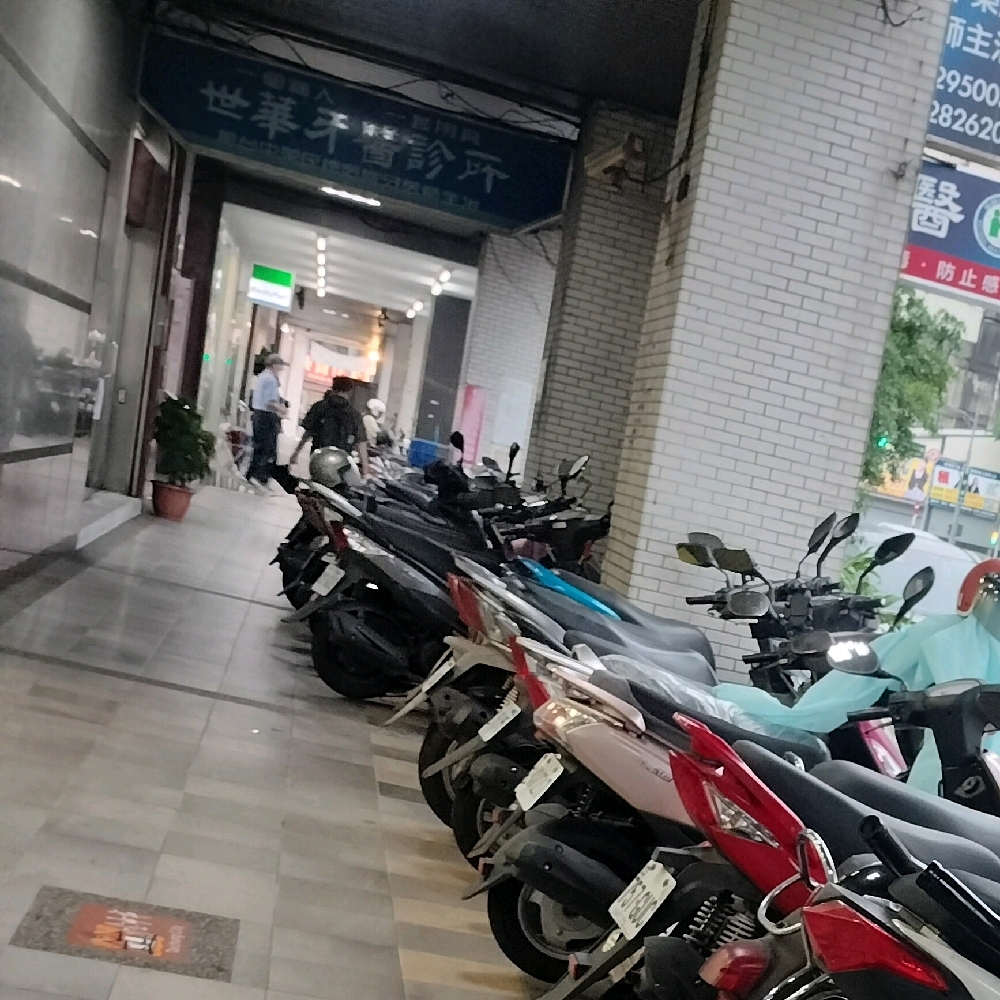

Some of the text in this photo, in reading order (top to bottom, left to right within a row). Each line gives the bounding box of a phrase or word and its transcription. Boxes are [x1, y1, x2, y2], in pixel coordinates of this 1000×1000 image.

[200, 80, 510, 194] 世華牙醫診所
[910, 173, 966, 239] 醫
